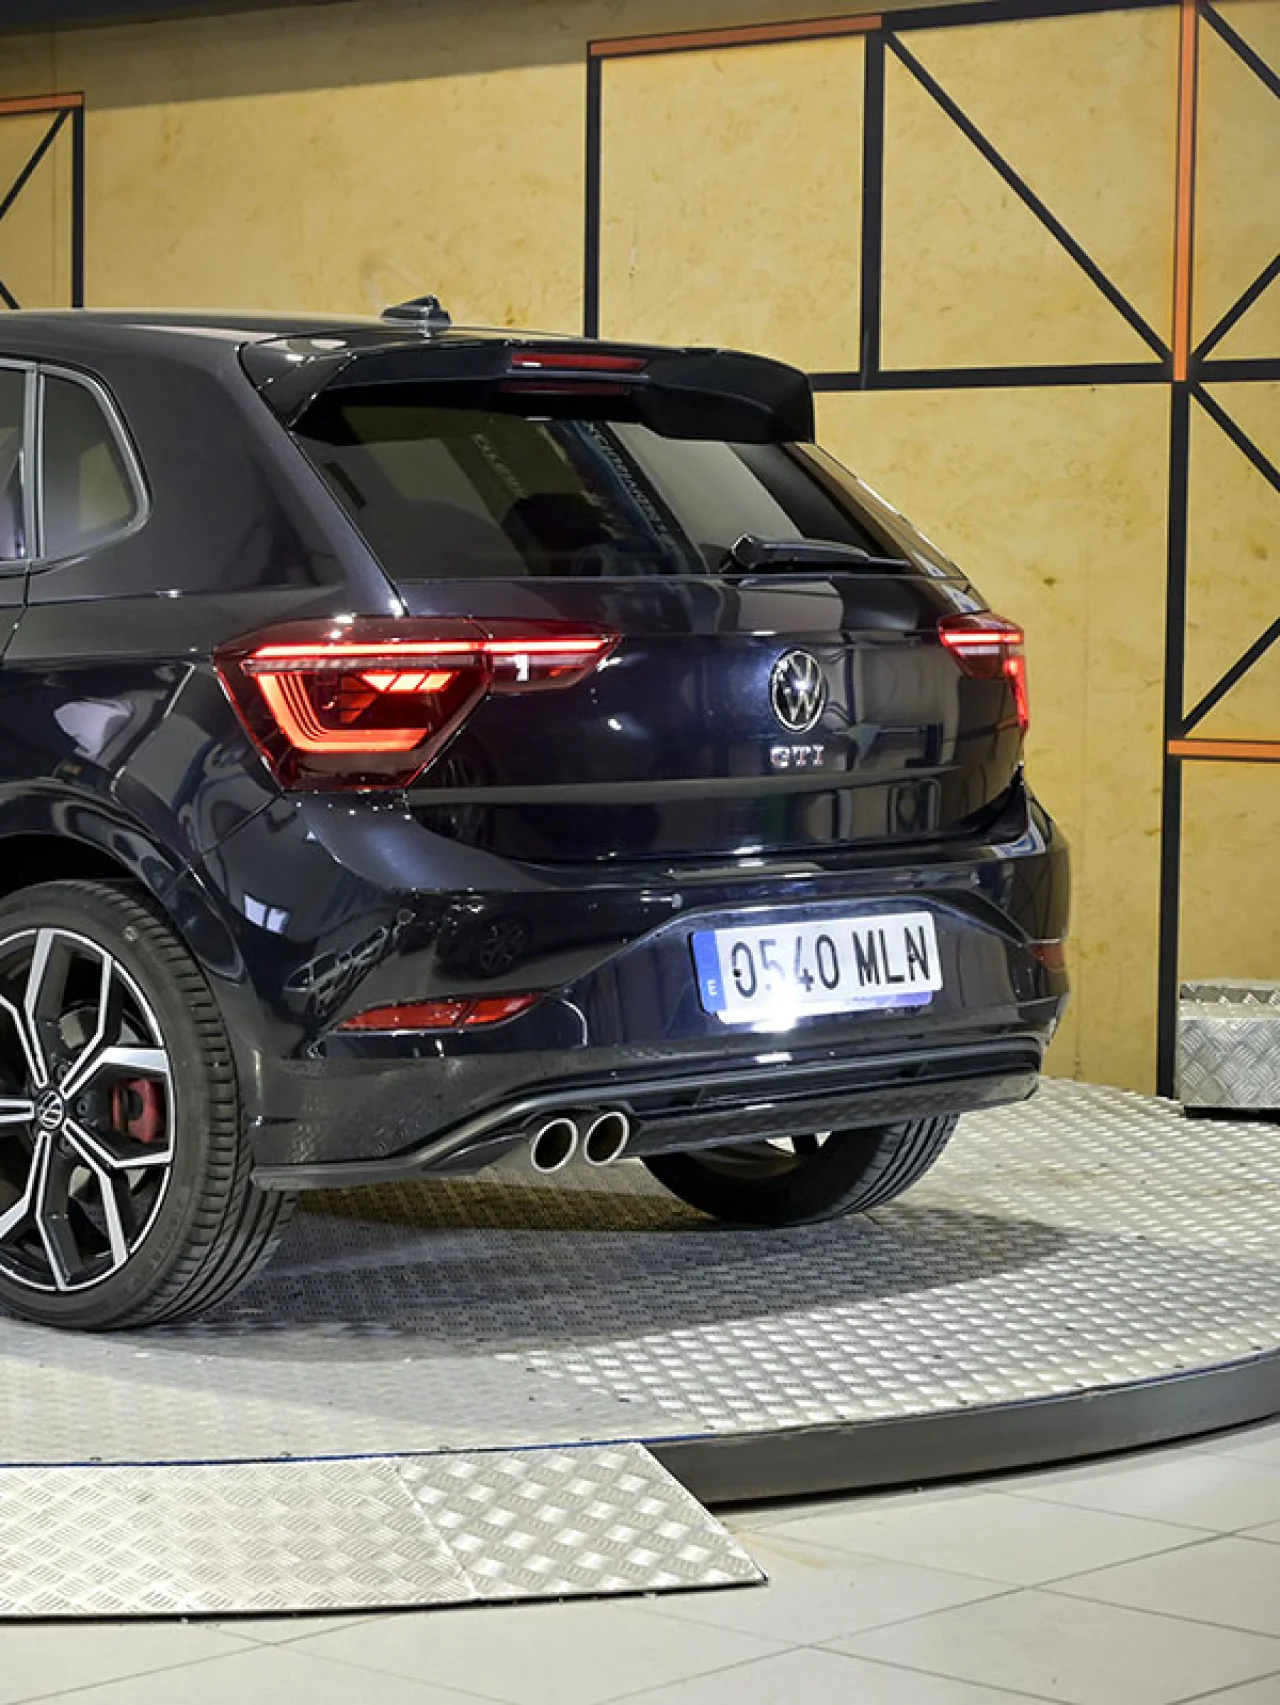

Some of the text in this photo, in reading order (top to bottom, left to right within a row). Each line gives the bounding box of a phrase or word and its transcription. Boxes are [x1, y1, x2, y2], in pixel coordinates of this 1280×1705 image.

[769, 744, 824, 768] GTI
[731, 926, 931, 998] 0540 MLN
